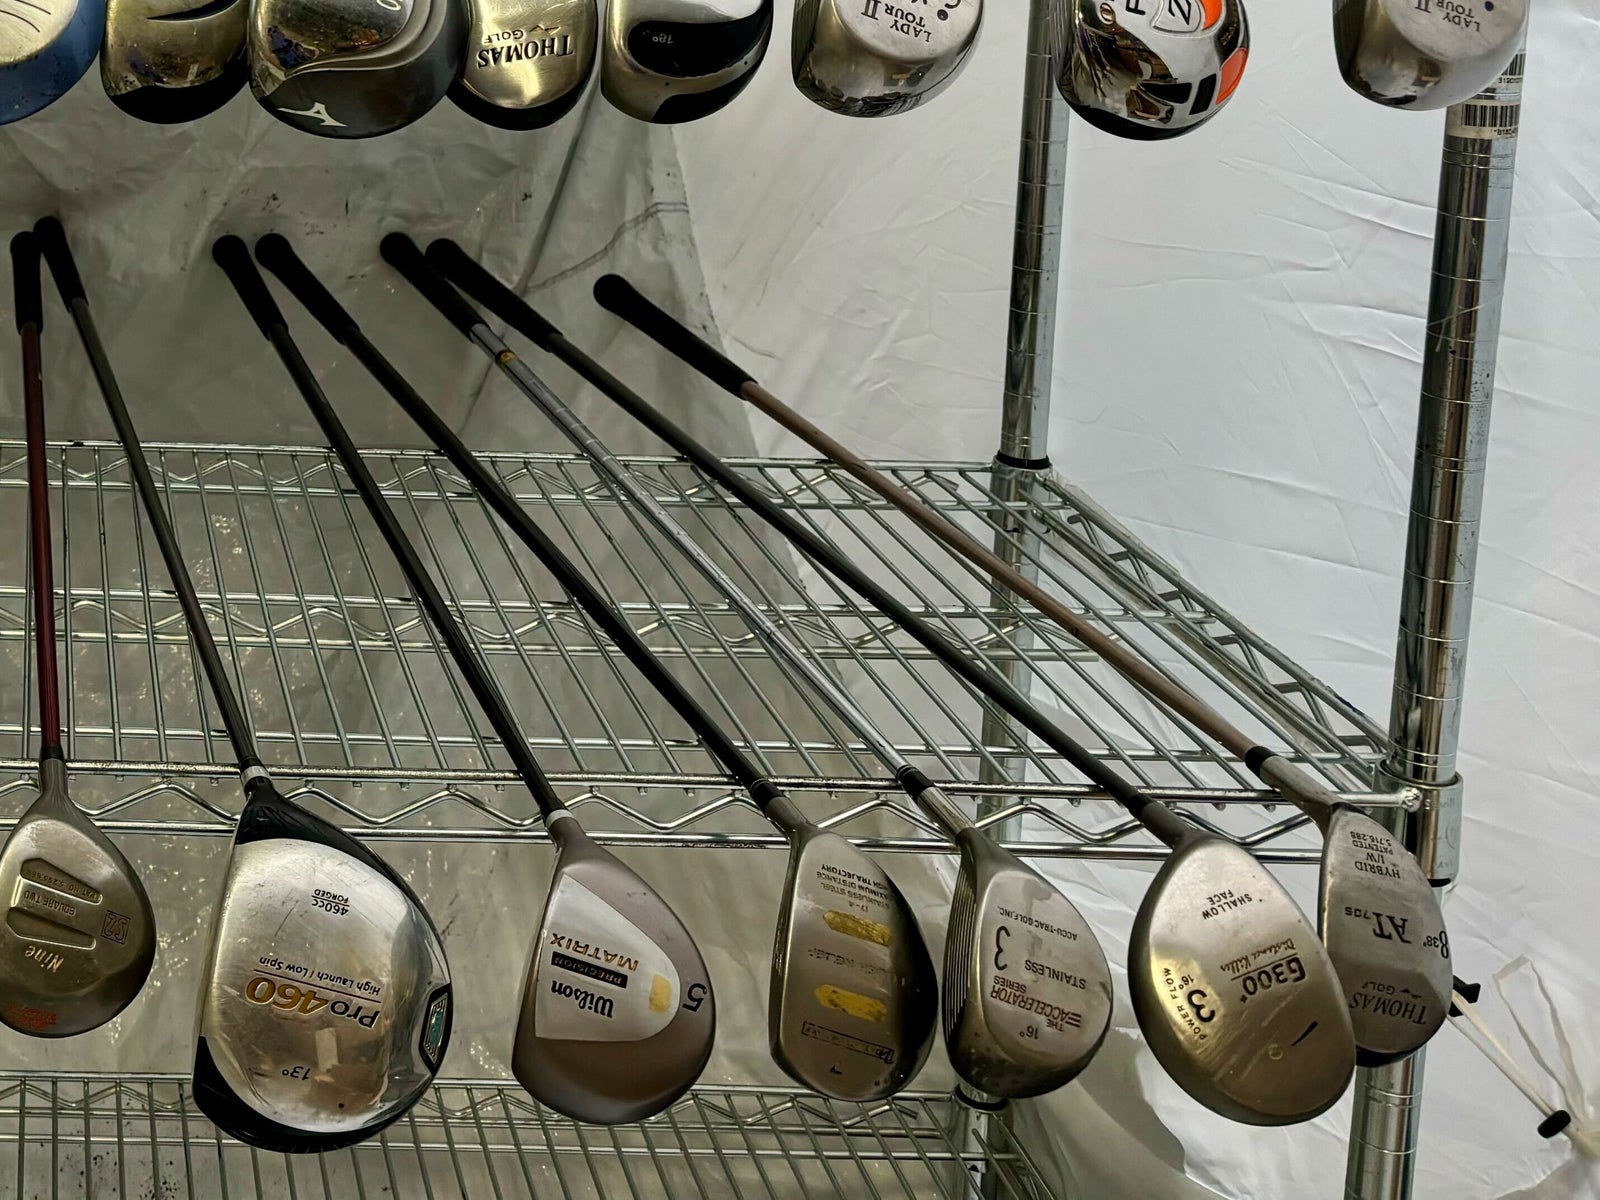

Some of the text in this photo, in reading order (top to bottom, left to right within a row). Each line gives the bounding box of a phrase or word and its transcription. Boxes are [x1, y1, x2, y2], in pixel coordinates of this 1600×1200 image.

[885, 5, 926, 28] TOUR
[1443, 12, 1480, 32] LADY
[482, 30, 523, 44] GOLF
[652, 34, 672, 44] 18°
[890, 19, 932, 42] LADY
[478, 34, 573, 68] THOMAS
[1352, 839, 1393, 855] PATENTED
[1366, 852, 1385, 864] I/W
[816, 872, 855, 889] DISTANCE
[821, 864, 871, 888] TRAJECTORY
[1354, 861, 1400, 879] HYBRID
[313, 888, 349, 904] FORGED
[821, 882, 848, 896] STEEL
[1207, 889, 1234, 904] FACE
[24, 889, 76, 916] SQUARE TWO
[312, 897, 348, 916] 460cc
[1202, 893, 1253, 919] SHALLOW
[1038, 920, 1077, 940] ACCU-TRAC
[1344, 907, 1411, 943] AT 705
[551, 933, 638, 972] MATRIX
[996, 925, 1010, 970] 3
[1220, 938, 1294, 972] Distance Killer
[1423, 931, 1449, 959] 8 38°
[25, 943, 64, 972] Nine
[260, 956, 381, 996] High Launch Low Spin
[554, 956, 621, 984] PRECISION
[1024, 960, 1086, 989] STAINLESS
[1177, 973, 1194, 989] 16°
[994, 975, 1026, 993] SERIES
[1362, 982, 1394, 995] GOLF
[551, 979, 614, 1018] Wilson
[683, 984, 707, 1012] 5
[990, 985, 1072, 1019] ACCELERATOR
[1163, 966, 1206, 1040] POWER FLOW
[1187, 989, 1216, 1022] 3
[1350, 991, 1427, 1024] THOMAS
[1019, 1025, 1038, 1039] 16°
[1046, 1019, 1064, 1033] THE
[282, 1066, 312, 1082] 13°
